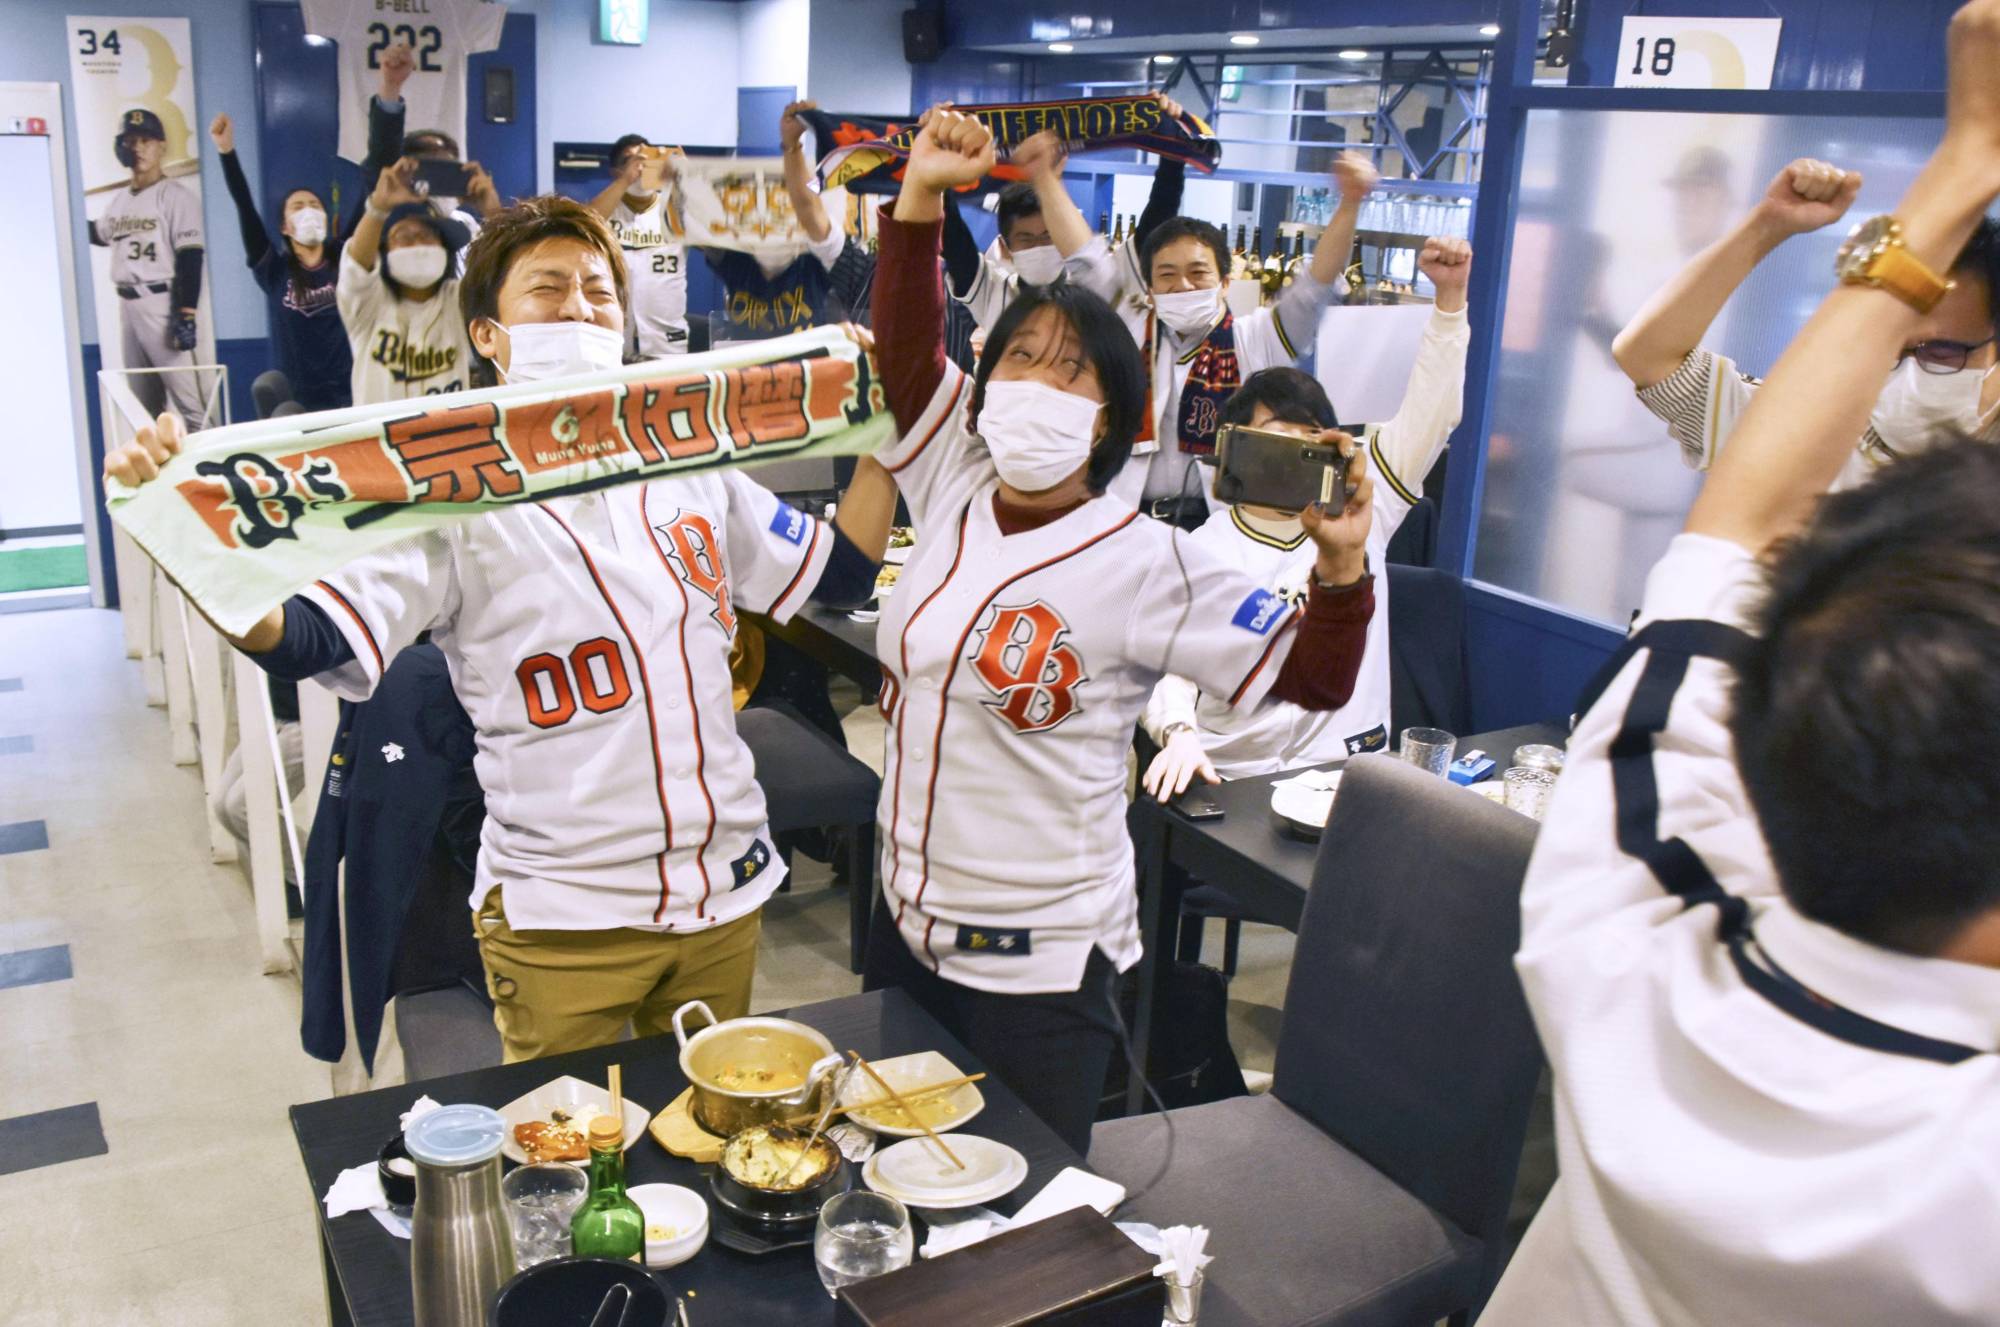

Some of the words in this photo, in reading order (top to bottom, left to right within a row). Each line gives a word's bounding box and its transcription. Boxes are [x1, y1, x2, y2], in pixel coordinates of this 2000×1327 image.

[78, 29, 121, 55] 34
[1632, 37, 1676, 76] 18
[966, 100, 1161, 148] UFFALOES
[128, 241, 157, 262] 34
[652, 253, 679, 274] 23
[551, 404, 580, 443] 6
[514, 636, 633, 729] 00
